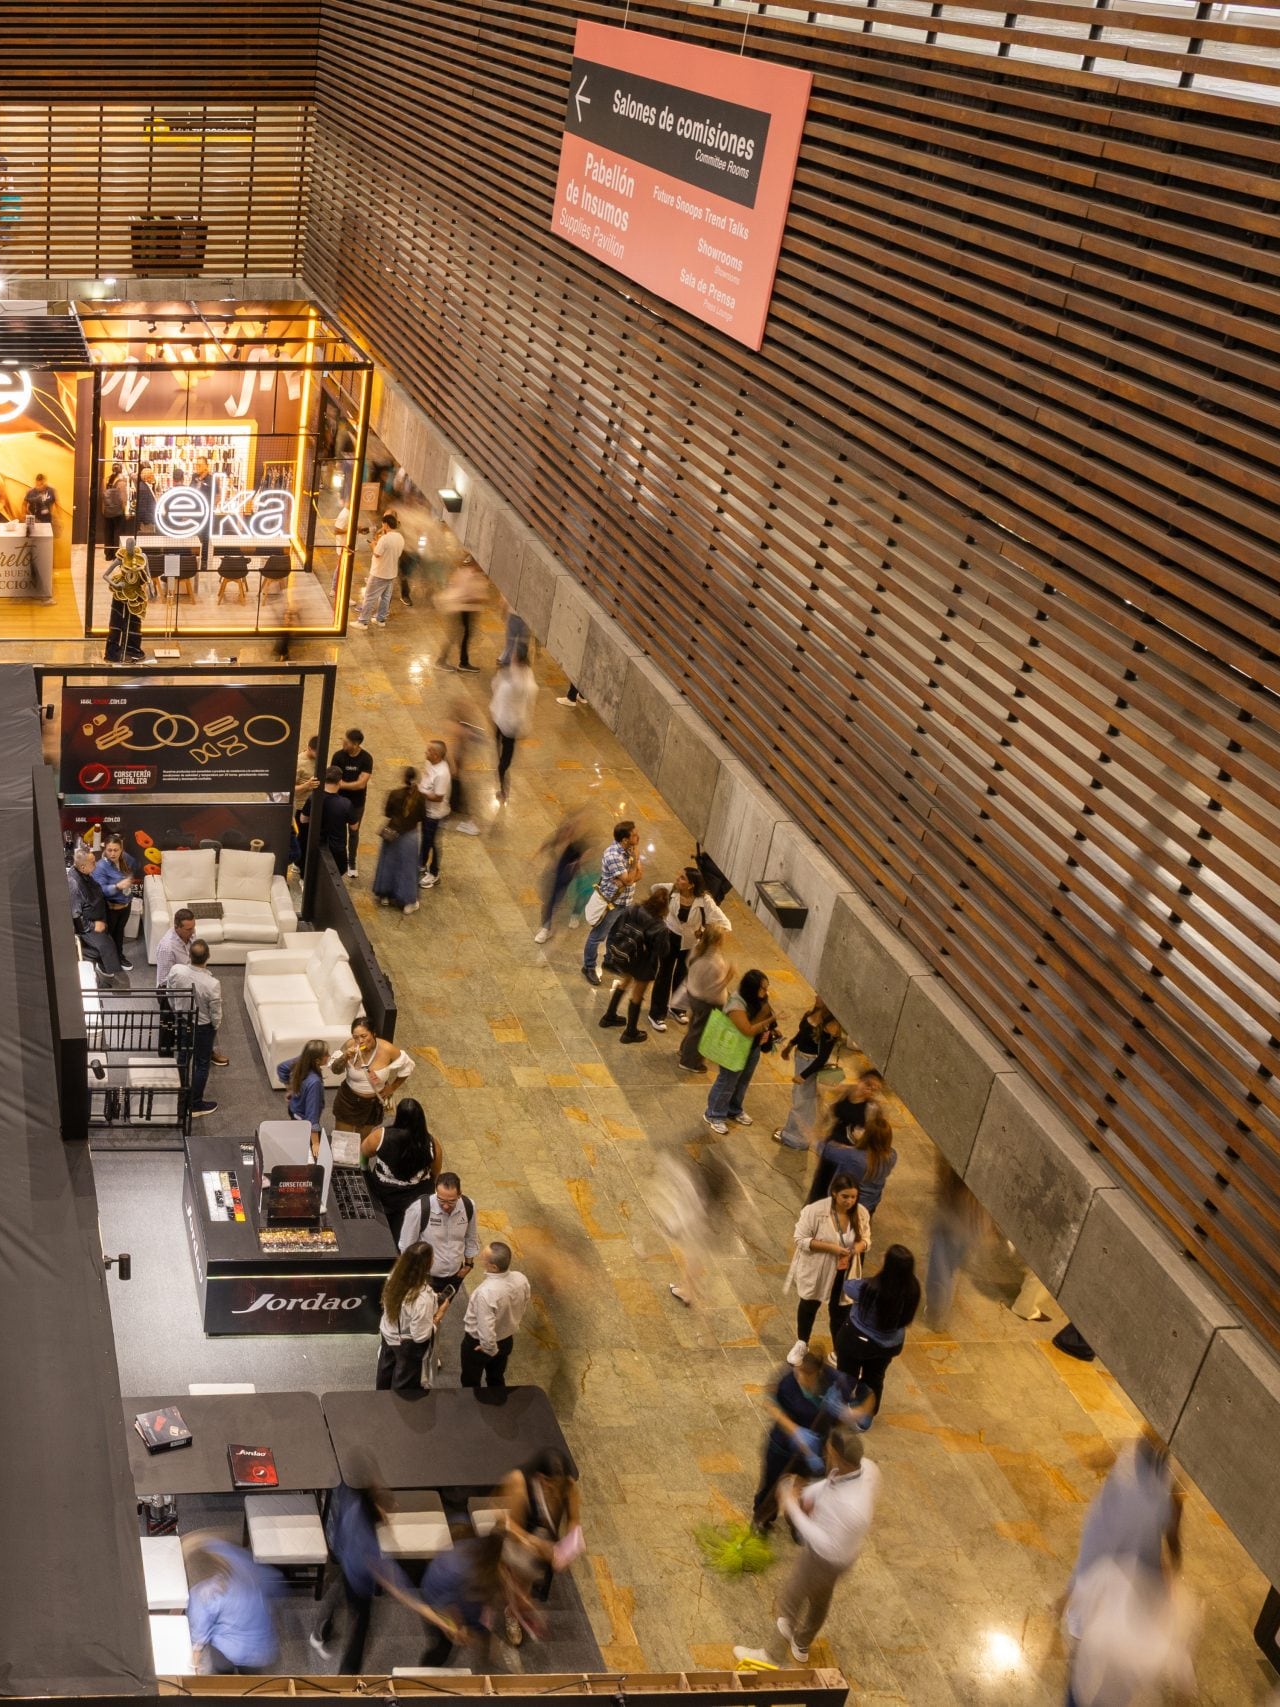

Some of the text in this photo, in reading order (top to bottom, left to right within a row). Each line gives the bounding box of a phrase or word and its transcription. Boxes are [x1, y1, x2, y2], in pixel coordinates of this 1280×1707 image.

[612, 89, 755, 161] Salones de comisiones
[584, 152, 635, 198] Pabellón
[695, 149, 750, 179] Committee Rooms
[566, 178, 629, 232] de Insumos
[652, 185, 750, 240] Future Snoops Trend Talks
[559, 207, 625, 260] Supplies Pavilion
[697, 237, 743, 272] Showrooms
[679, 268, 736, 309] Sala de Prensa
[154, 472, 296, 539] eka
[113, 769, 151, 778] CORSETERÍA
[117, 776, 147, 785] METÁLICA
[231, 1292, 363, 1314] Jordao
